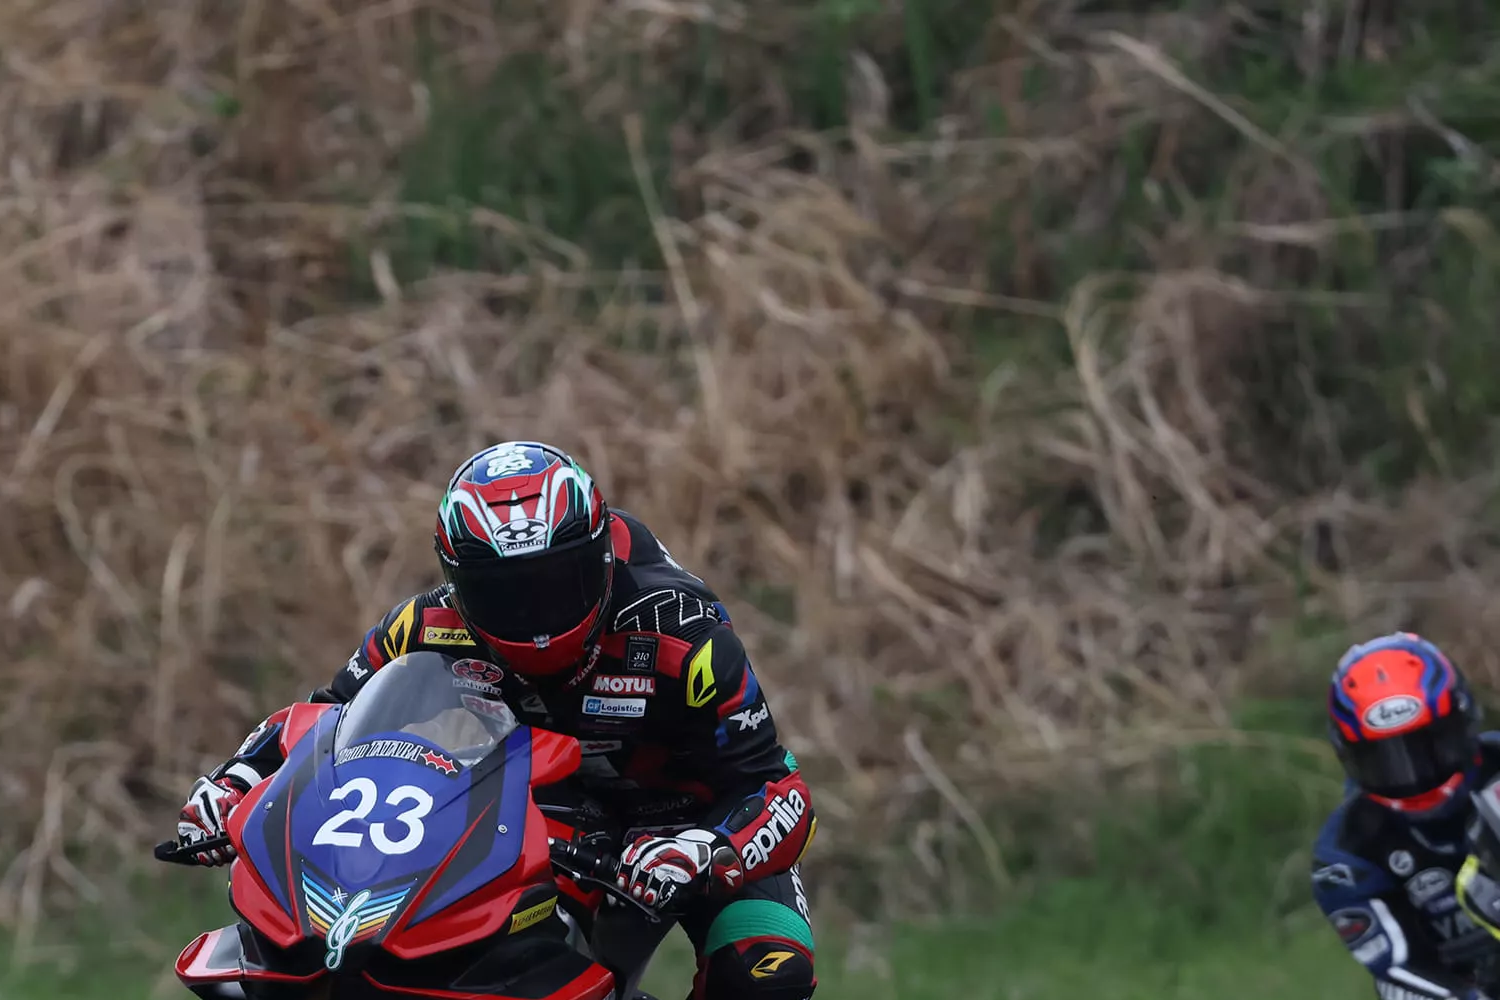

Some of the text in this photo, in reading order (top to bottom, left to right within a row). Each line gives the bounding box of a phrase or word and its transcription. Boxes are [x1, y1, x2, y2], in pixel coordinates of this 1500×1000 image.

[439, 632, 474, 641] DUN
[593, 676, 654, 693] MOTUL
[601, 703, 643, 713] Logistics
[729, 702, 769, 731] Xpd
[312, 777, 433, 855] 23
[742, 788, 806, 870] aprilia
